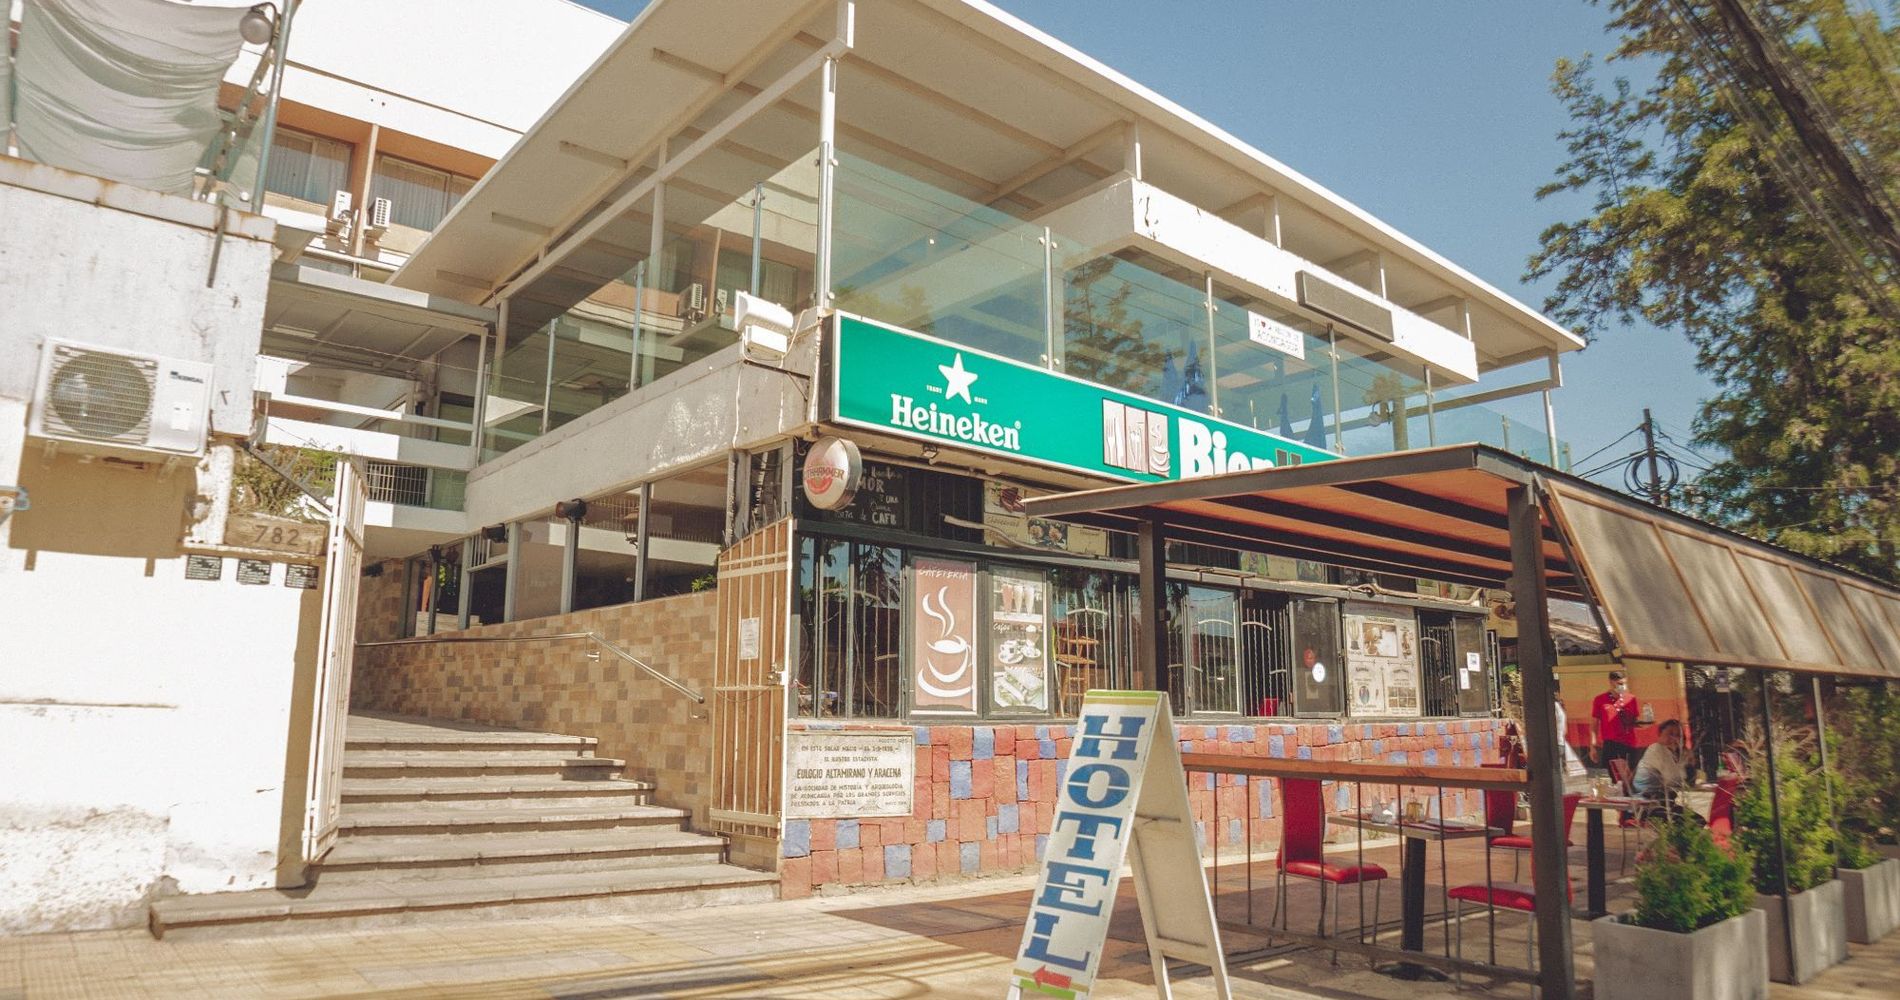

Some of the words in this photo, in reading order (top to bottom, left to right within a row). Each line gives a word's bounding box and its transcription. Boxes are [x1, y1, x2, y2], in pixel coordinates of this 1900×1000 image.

[890, 393, 1020, 450] Heineken
[1178, 416, 1276, 480] Bi
[255, 524, 300, 546] 782
[796, 768, 823, 779] EULOGIO
[825, 768, 866, 779] ALTAMIRANO
[868, 768, 873, 778] Y
[874, 767, 902, 778] ARACENA
[1023, 715, 1146, 971] HOTEL
